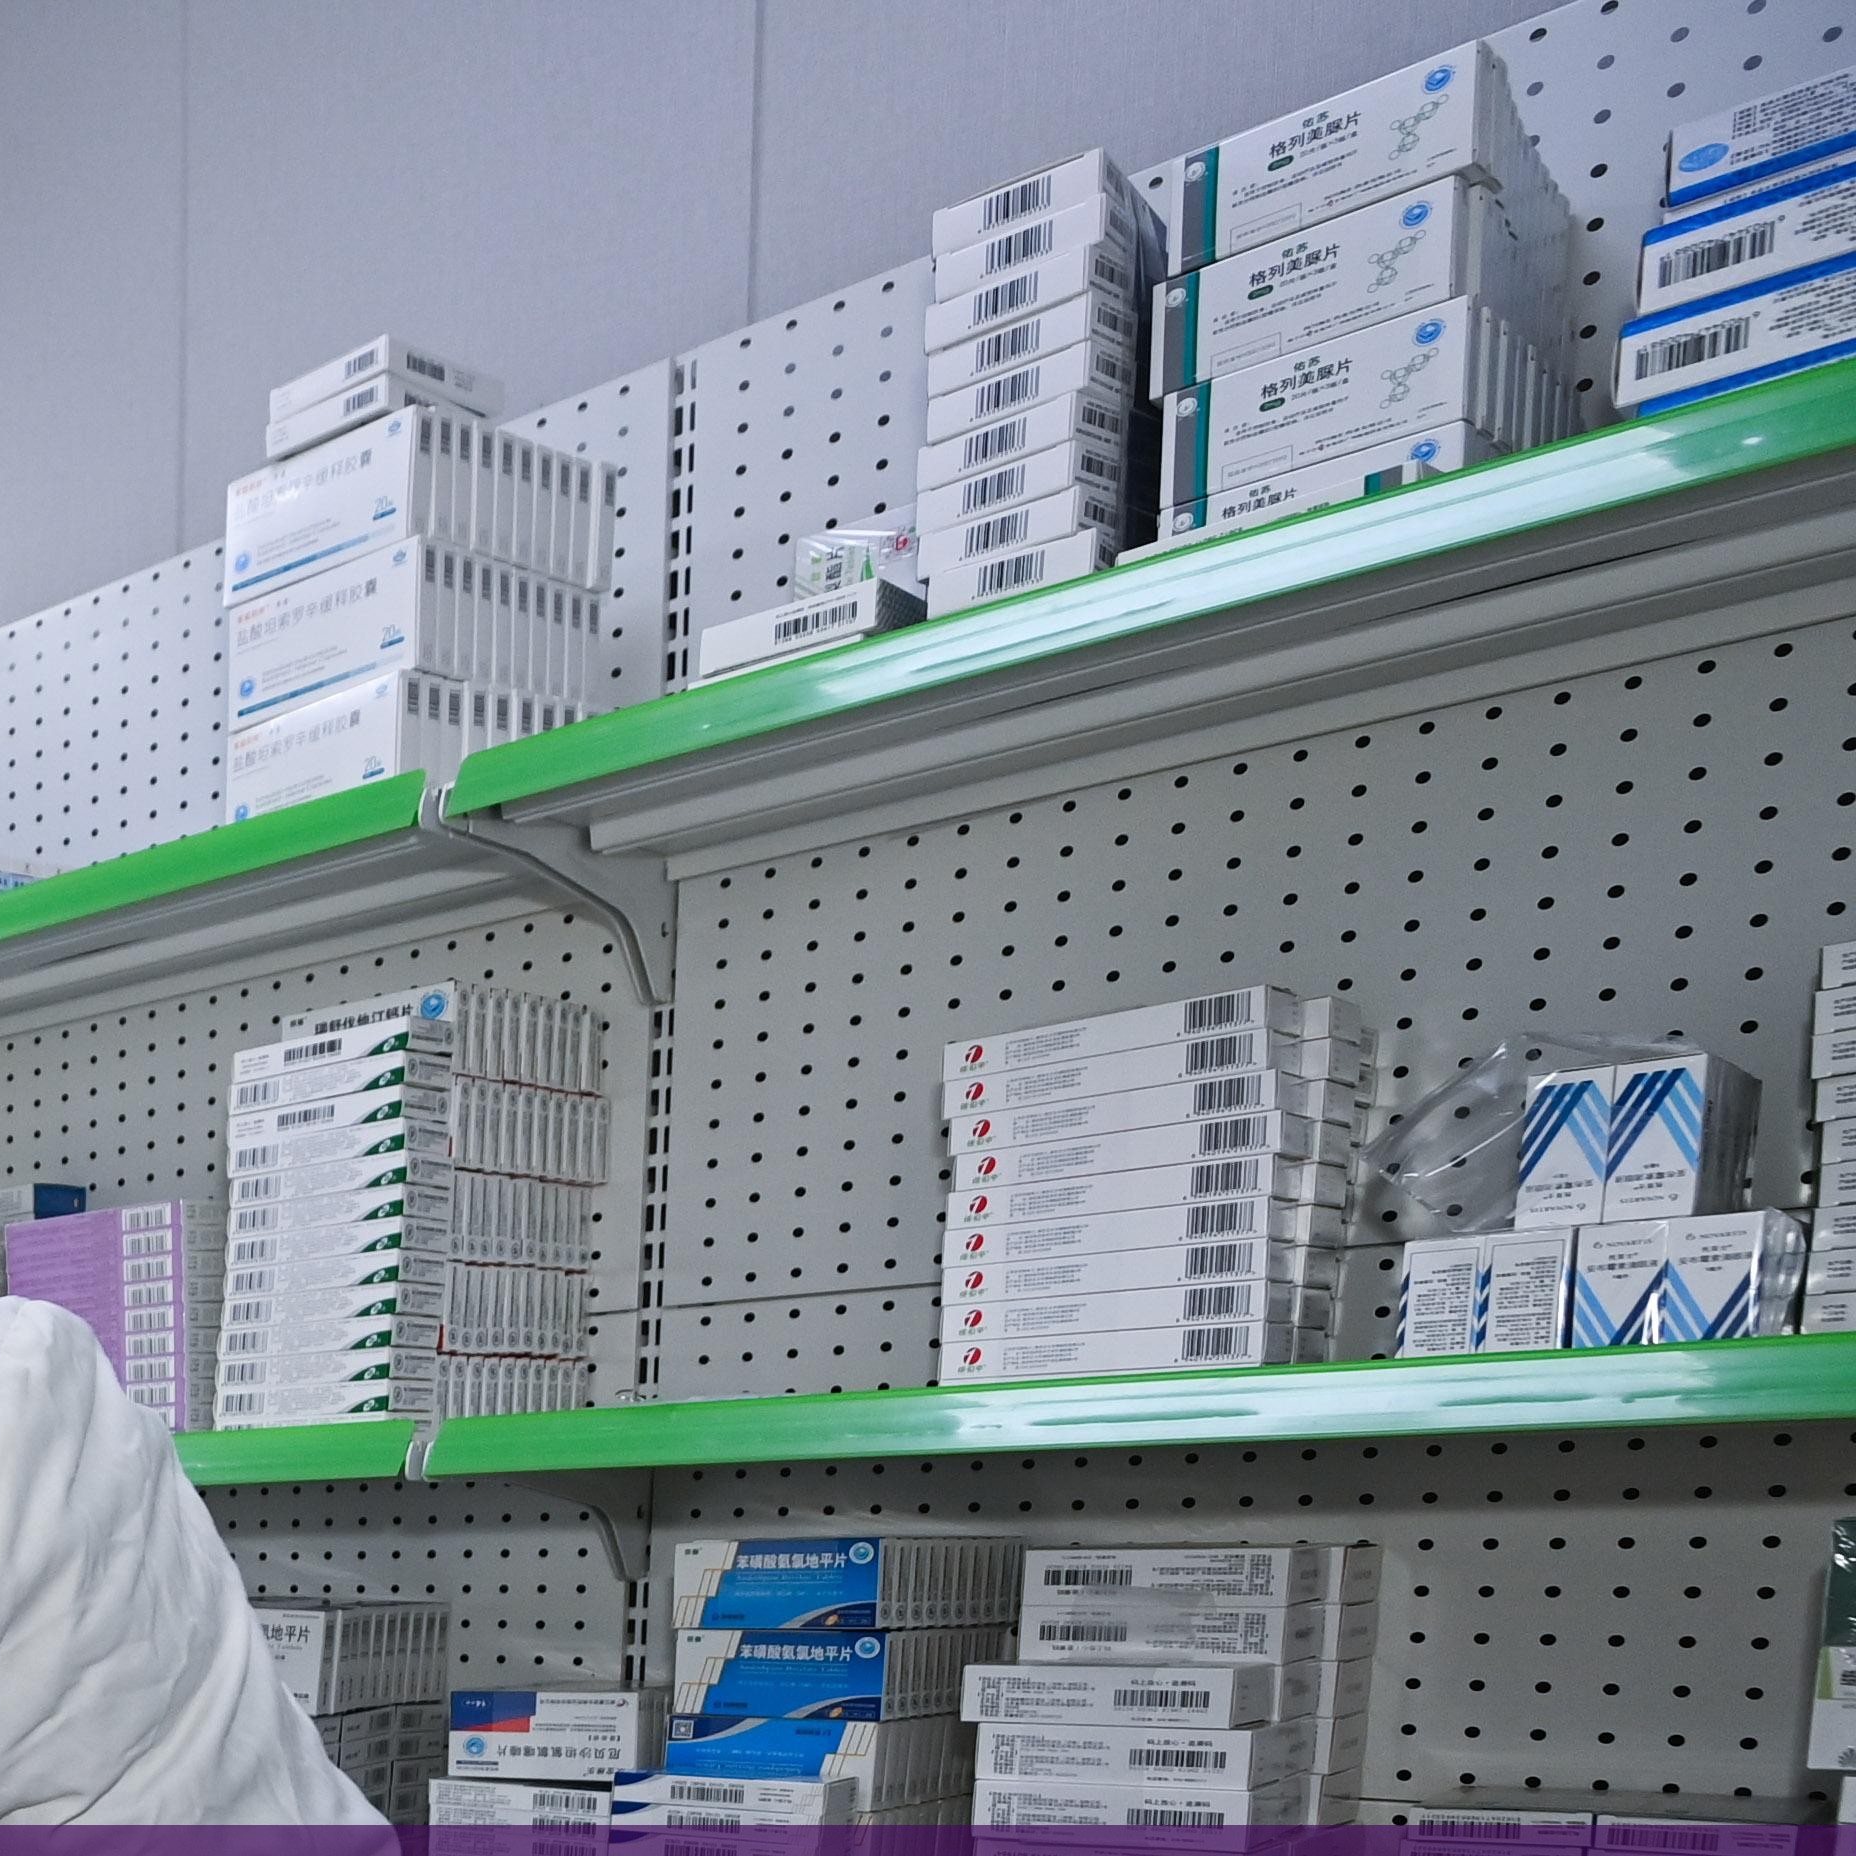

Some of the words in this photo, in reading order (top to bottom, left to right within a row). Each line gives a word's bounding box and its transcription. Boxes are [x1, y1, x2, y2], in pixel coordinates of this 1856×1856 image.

[1268, 111, 1363, 159] 格列美脲片
[1248, 243, 1341, 287] 格列美脲片
[1260, 358, 1353, 398] 格列美脲片
[1221, 487, 1298, 519] 格列美脲片
[236, 578, 378, 646] 盐酸坦索罗辛缓释胶囊
[232, 709, 362, 772] 盐酸坦索罗辛缓释胶囊
[736, 1552, 848, 1569] 苯磺酸氨氯地平片
[739, 1644, 853, 1662] 苯磺酸氨氯地平片
[497, 1744, 622, 1761] 厄贝沙坦氢氯噻嗪片
